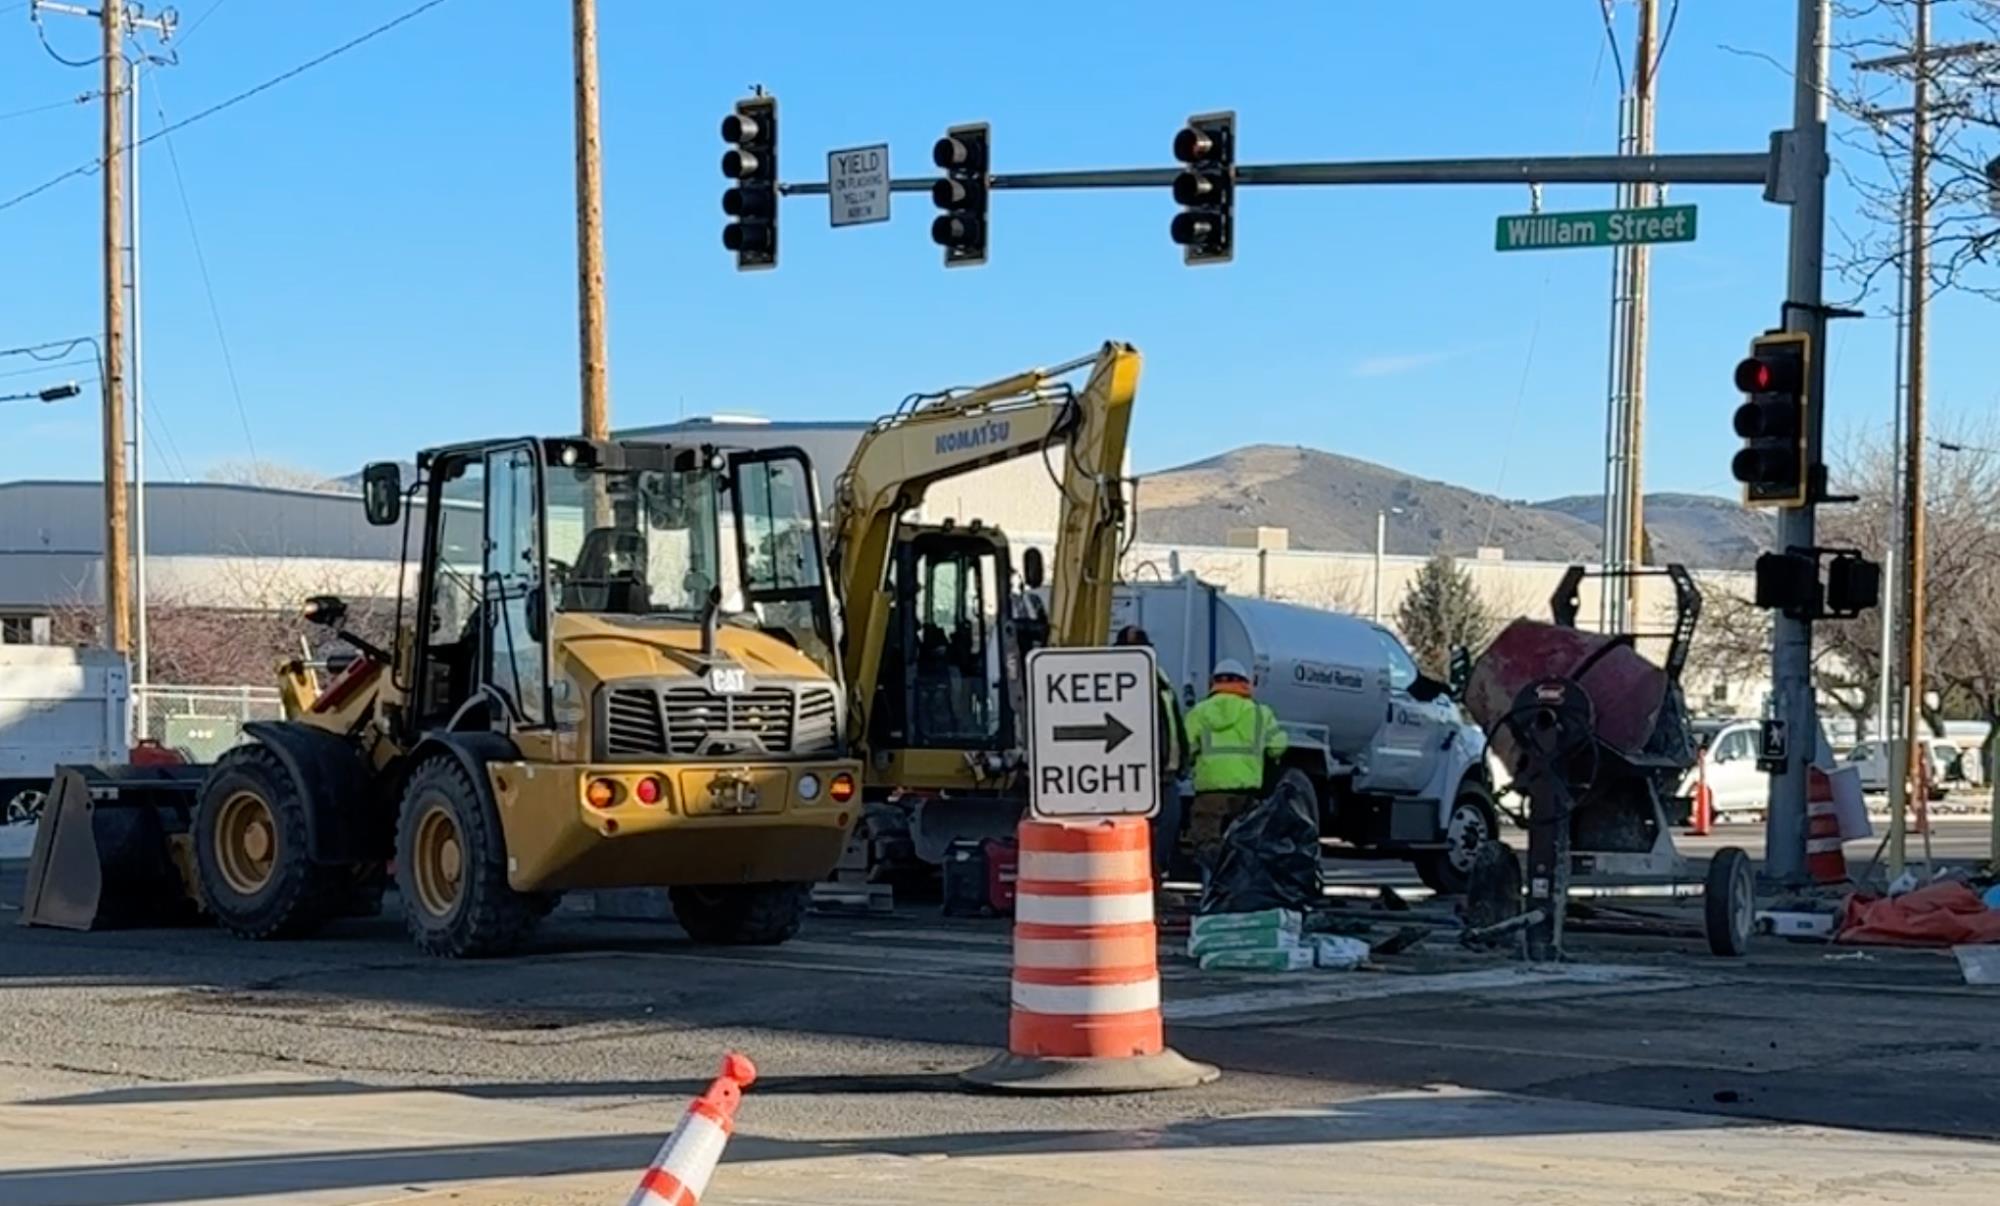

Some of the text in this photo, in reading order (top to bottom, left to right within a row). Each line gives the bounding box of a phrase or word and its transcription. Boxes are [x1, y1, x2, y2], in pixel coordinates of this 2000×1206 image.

[838, 152, 879, 175] YIELD
[1508, 211, 1686, 246] William Street
[935, 420, 1010, 454] KOMATSU
[713, 669, 745, 692] CAT
[1046, 672, 1137, 703] KEEP
[1041, 763, 1147, 794] RIGHT
